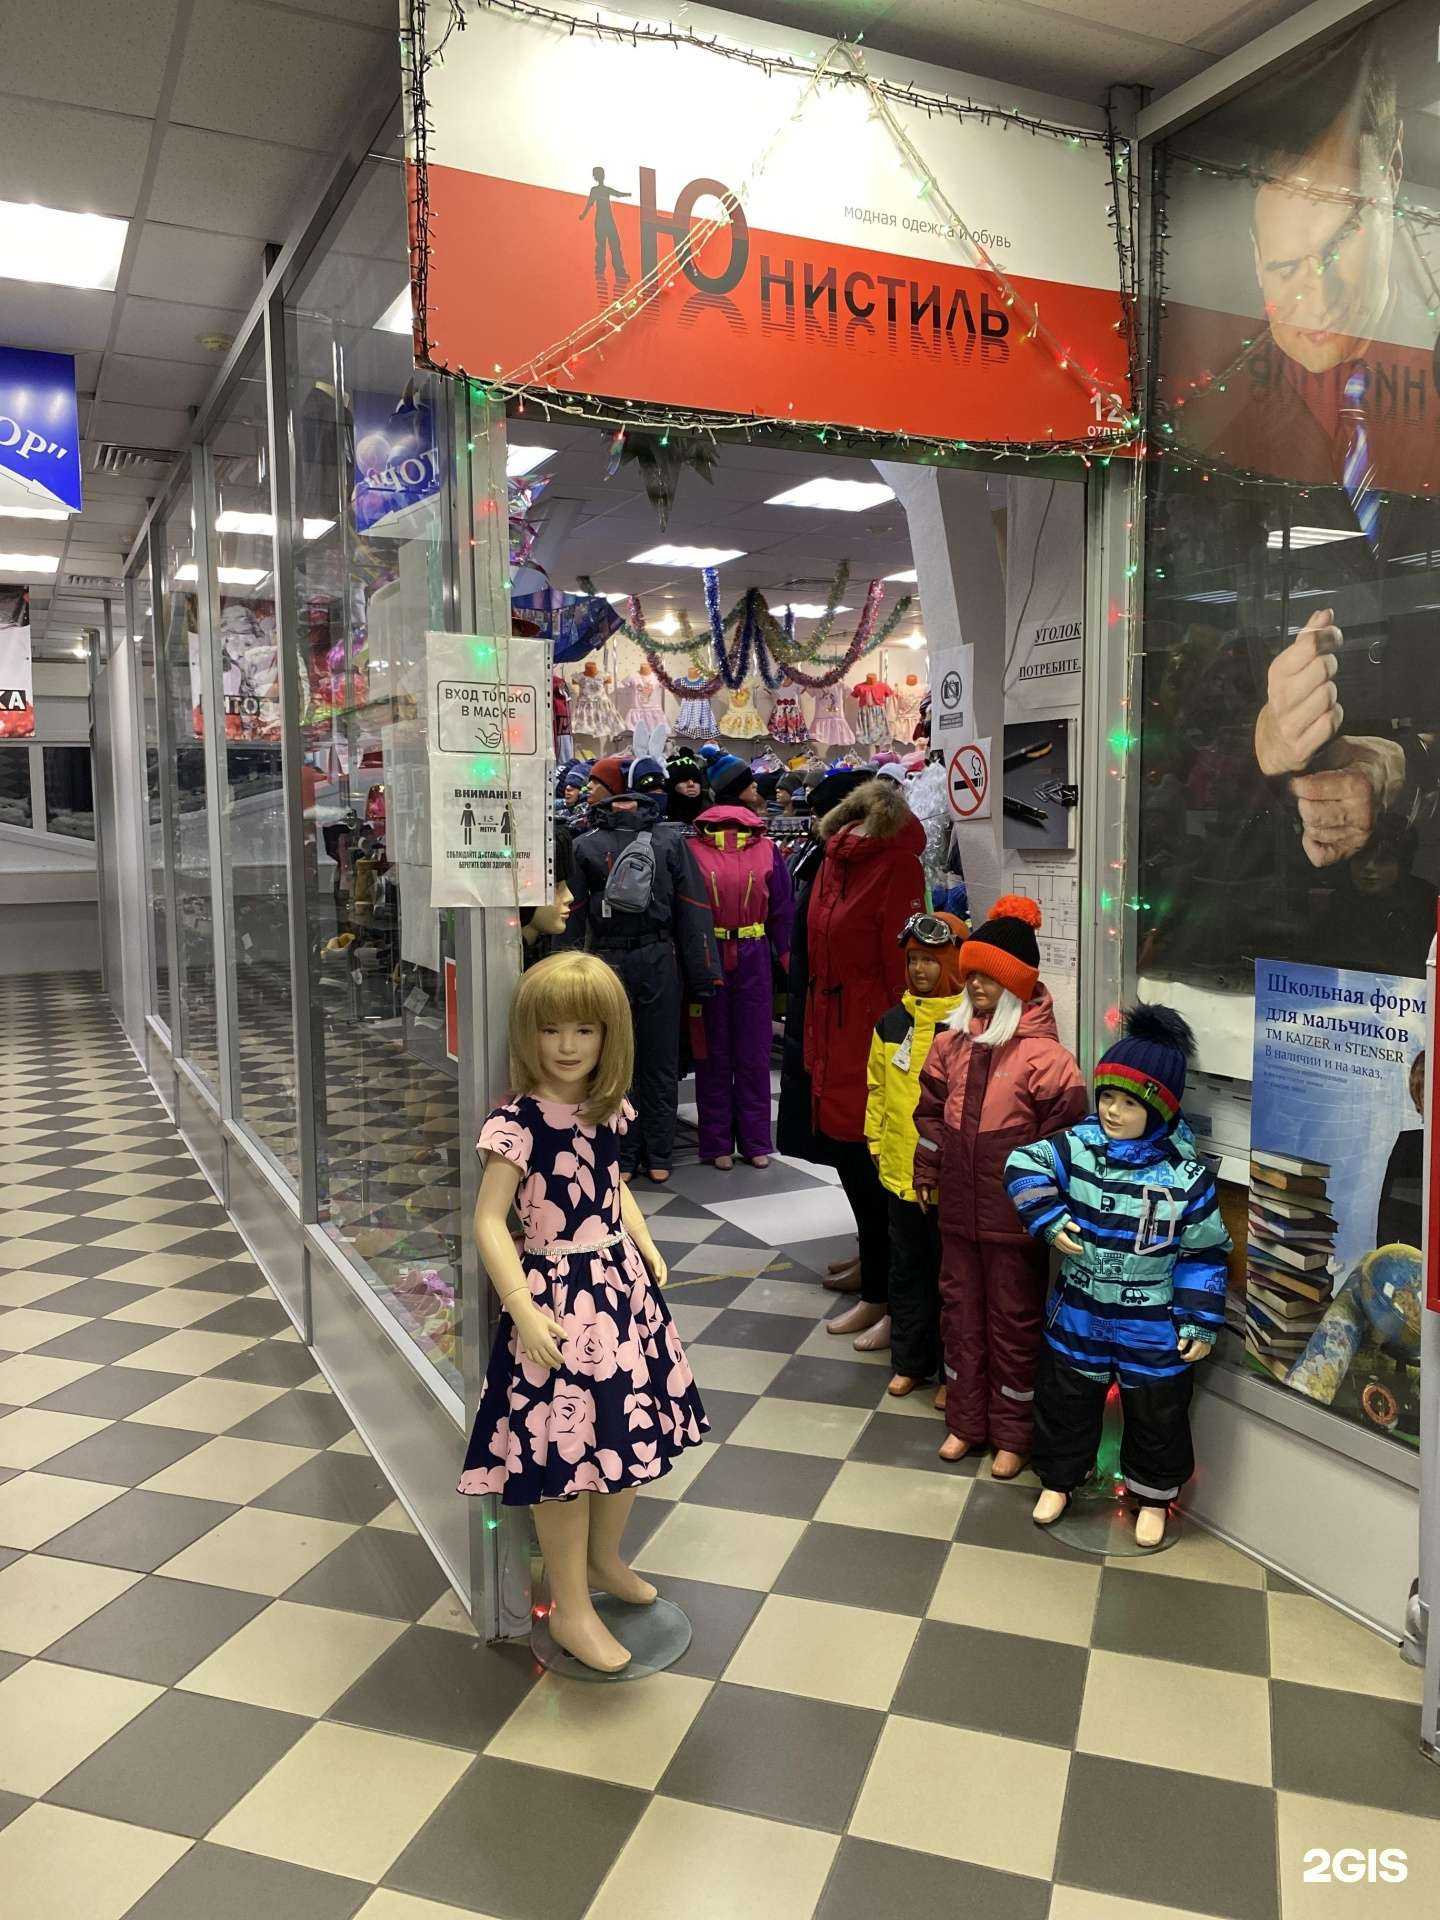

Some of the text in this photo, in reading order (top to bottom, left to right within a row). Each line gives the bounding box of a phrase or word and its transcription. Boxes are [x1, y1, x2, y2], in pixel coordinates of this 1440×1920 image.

[844, 206, 897, 227] модная
[959, 228, 967, 241] и
[972, 229, 1011, 249] обувь
[1090, 392, 1123, 422] 12
[1034, 622, 1082, 644] УГОЛОК
[1019, 659, 1082, 678] ПОТРЕБИТЕ
[445, 688, 531, 704] ВХОД ТОЛЬКО
[462, 705, 517, 719] В МАСКЕ
[1267, 972, 1364, 1005] Школьная
[1265, 1007, 1409, 1043] для мальчиков
[1265, 1028, 1405, 1064] ТМ KAIZER и STENSER
[1265, 1045, 1272, 1057] В
[1274, 1049, 1321, 1068] наличии
[1324, 1060, 1332, 1069] и
[1335, 1061, 1348, 1073] на
[1352, 1064, 1383, 1080] заказ.
